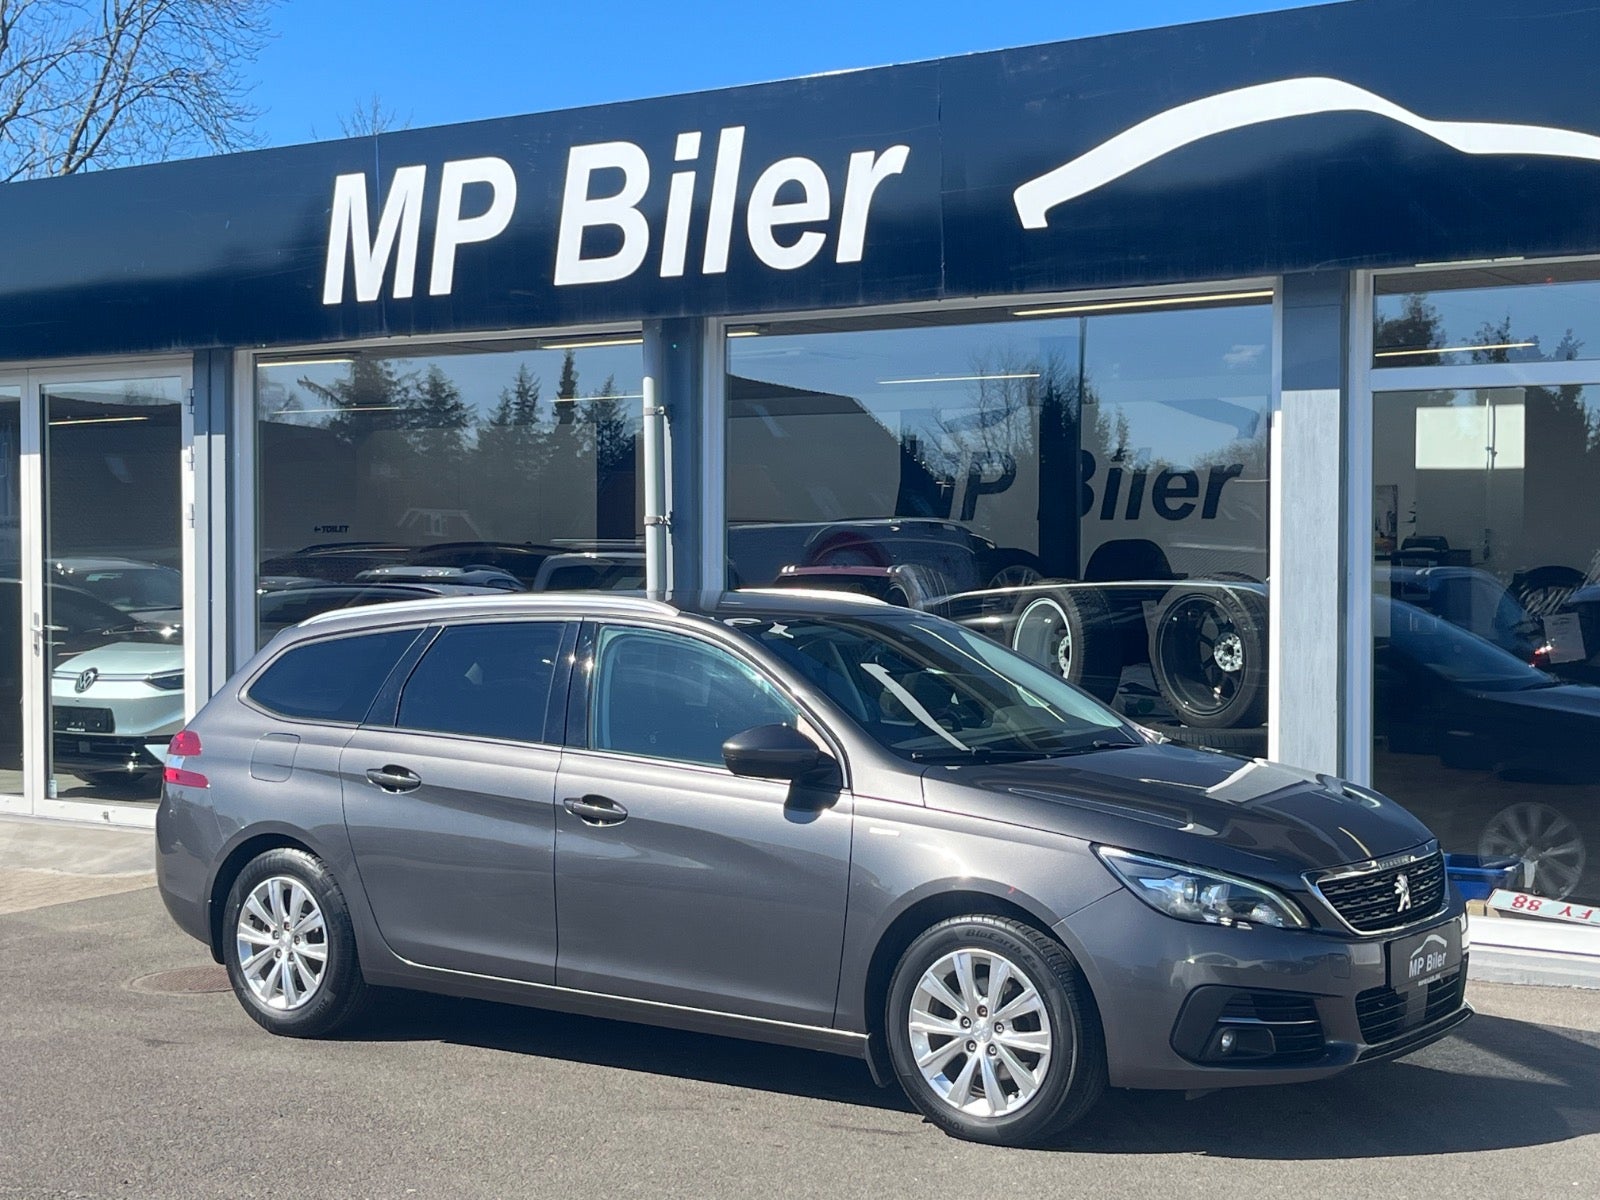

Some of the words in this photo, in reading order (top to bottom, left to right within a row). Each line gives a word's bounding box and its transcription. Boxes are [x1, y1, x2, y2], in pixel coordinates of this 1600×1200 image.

[323, 157, 517, 305] MP
[554, 126, 911, 287] Biler
[1408, 957, 1425, 978] MP
[1426, 951, 1447, 972] Biler
